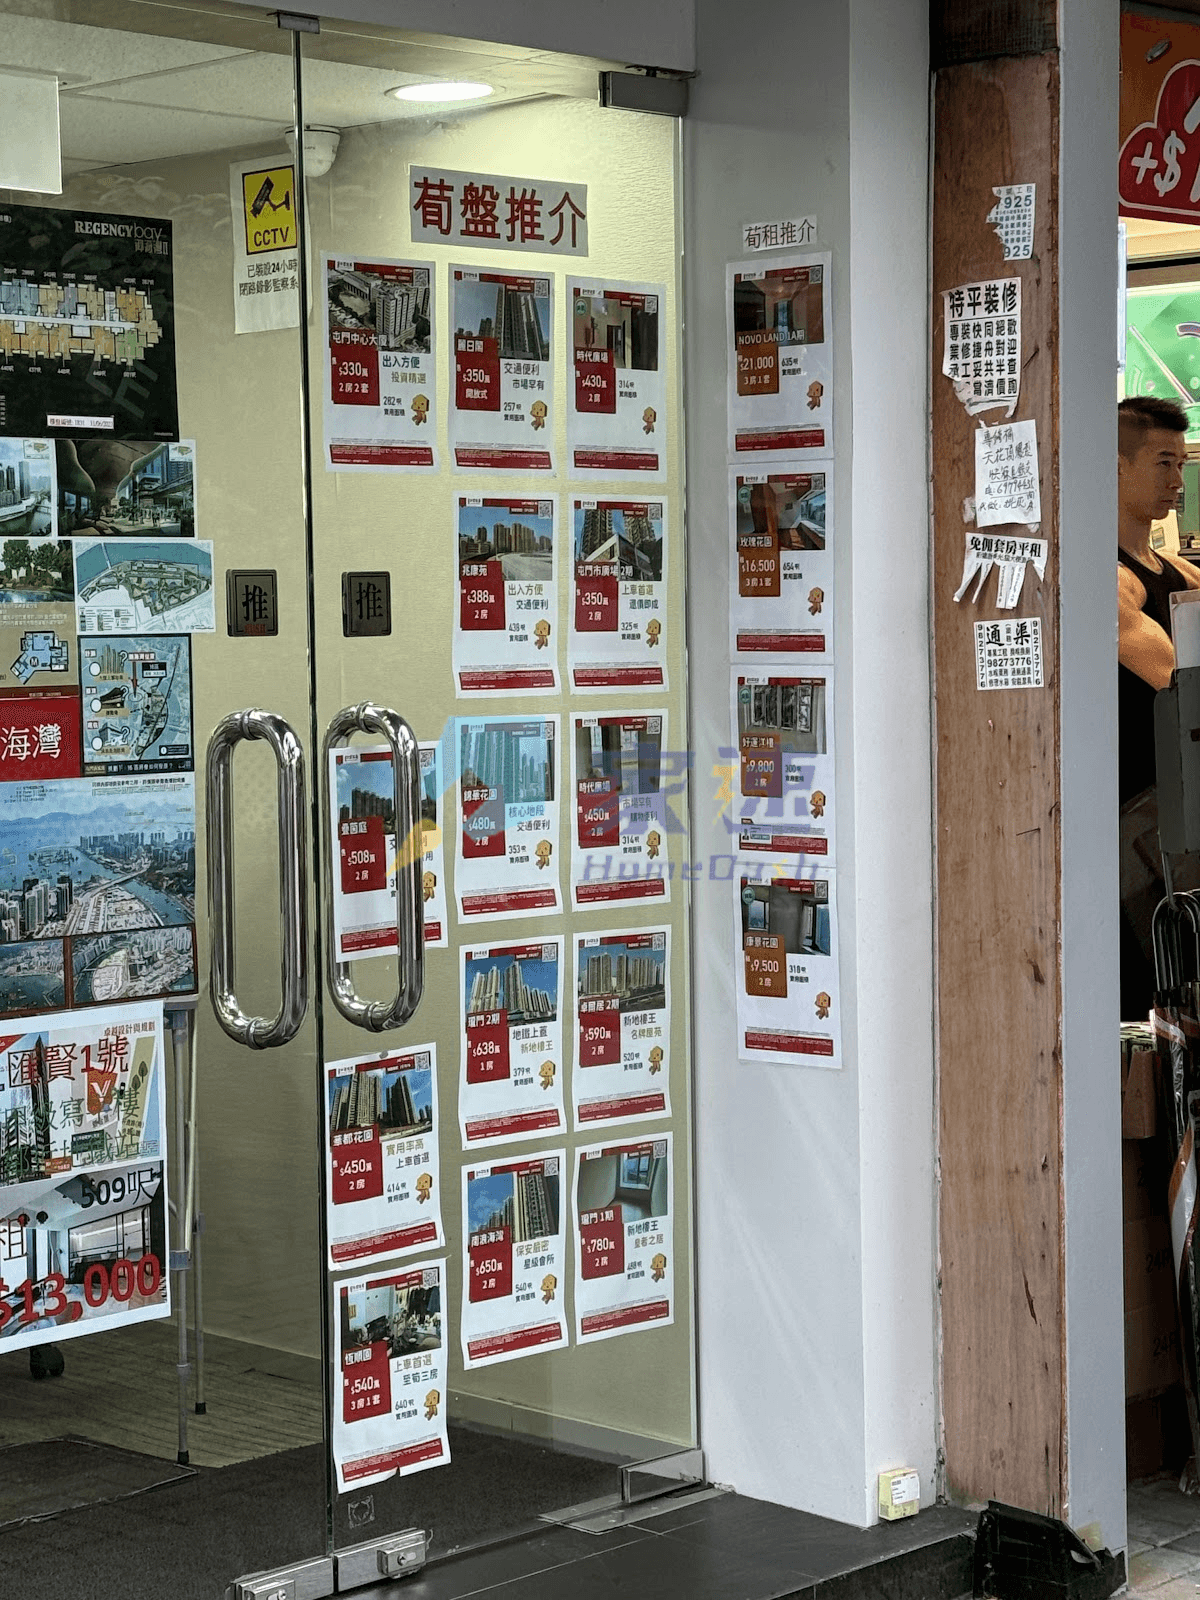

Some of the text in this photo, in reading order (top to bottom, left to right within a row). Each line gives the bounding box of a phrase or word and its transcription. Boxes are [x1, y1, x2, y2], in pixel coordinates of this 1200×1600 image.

[414, 176, 586, 248] 荀盤推介
[996, 195, 1032, 209] 925
[74, 220, 134, 238] REGENCY
[254, 226, 290, 248] CCTV
[744, 218, 815, 248] 荀租推介
[246, 259, 298, 278] 已裝設24小時
[239, 276, 300, 296] 閉路錄影監察系
[949, 282, 1017, 319] 特平裝修
[332, 332, 388, 347] 屯門中心大廈
[738, 334, 761, 344] NOVO
[764, 331, 784, 342] LAND
[949, 324, 959, 378] 專業承
[961, 322, 971, 384] 裝修工
[972, 322, 982, 396] 快捷妥當
[984, 321, 994, 396] 同舟共濟
[996, 320, 1005, 395] 絕對半價
[1007, 319, 1017, 394] 歡迎查詢
[382, 356, 420, 369] 出入方便
[504, 362, 539, 375] 交通便利
[391, 372, 426, 384] 投資精選
[970, 536, 1041, 558] 免佣套房平租
[356, 582, 384, 620] 推
[508, 584, 543, 596] 出入方便
[242, 584, 269, 622] 推
[516, 599, 548, 610] 交通便利
[978, 624, 986, 688] 98273776
[987, 657, 1031, 668] 98273776
[1032, 620, 1040, 685] 98273776
[0, 723, 62, 761] 海灣
[509, 805, 545, 818] 核心地段
[517, 820, 550, 832] 交通便利
[8, 1036, 129, 1088] 匯賢1號
[396, 1152, 430, 1169] 上車首選
[81, 1168, 154, 1208] 509呎
[524, 1254, 554, 1270] 星級會所
[394, 1354, 432, 1373] 上車首選
